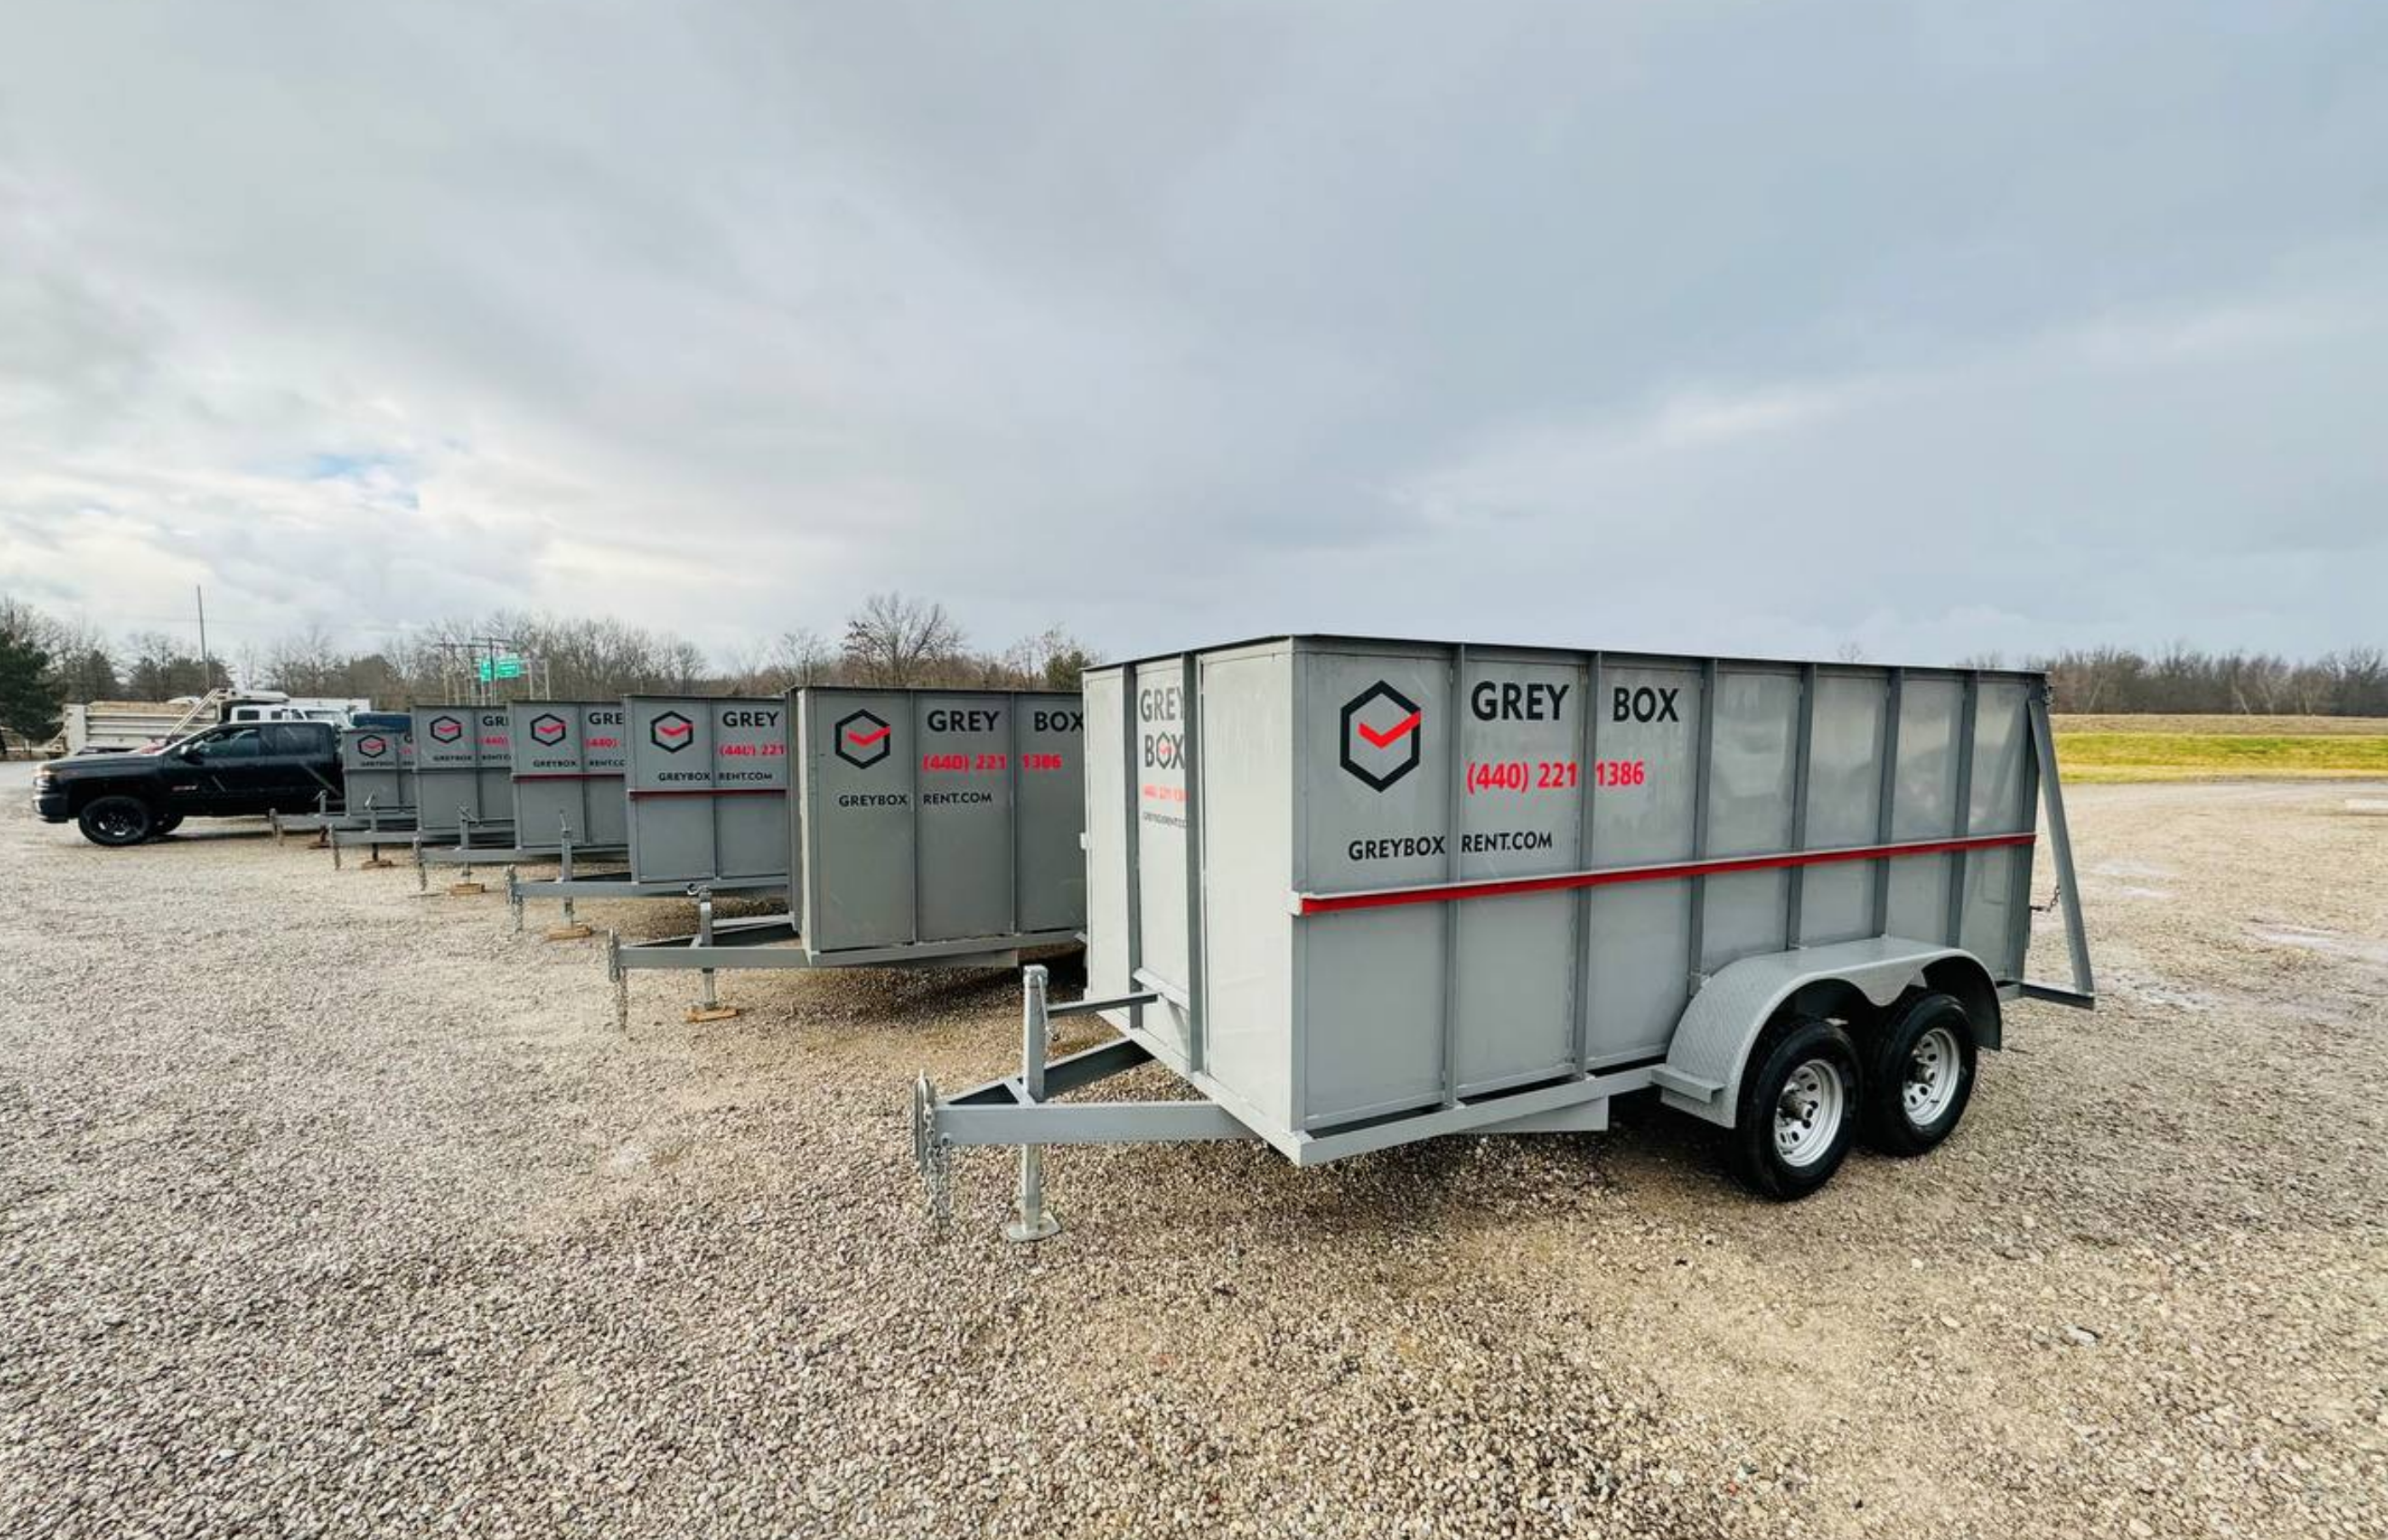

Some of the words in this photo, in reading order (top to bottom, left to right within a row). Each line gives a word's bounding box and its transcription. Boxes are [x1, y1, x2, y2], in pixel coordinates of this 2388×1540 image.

[1471, 681, 1570, 721] GREY
[1612, 687, 1679, 722] BOX
[482, 716, 509, 727] GR
[588, 712, 624, 725] GRE
[722, 711, 780, 727] GREY
[927, 710, 1000, 732] GREY
[1034, 711, 1084, 732] BOX
[761, 744, 785, 756] 221
[922, 754, 969, 774] (440)
[975, 754, 1007, 770] 221
[1021, 754, 1062, 770] 1386
[658, 772, 711, 782] GREYBOX
[1466, 762, 1529, 795] (440)
[1537, 762, 1578, 789] 221
[1595, 761, 1645, 787] 1386
[839, 793, 908, 808] GREYBOX
[923, 792, 992, 805] RENT.COM
[1348, 835, 1446, 861] GREYBOX
[1461, 831, 1553, 853] RENT.COM
